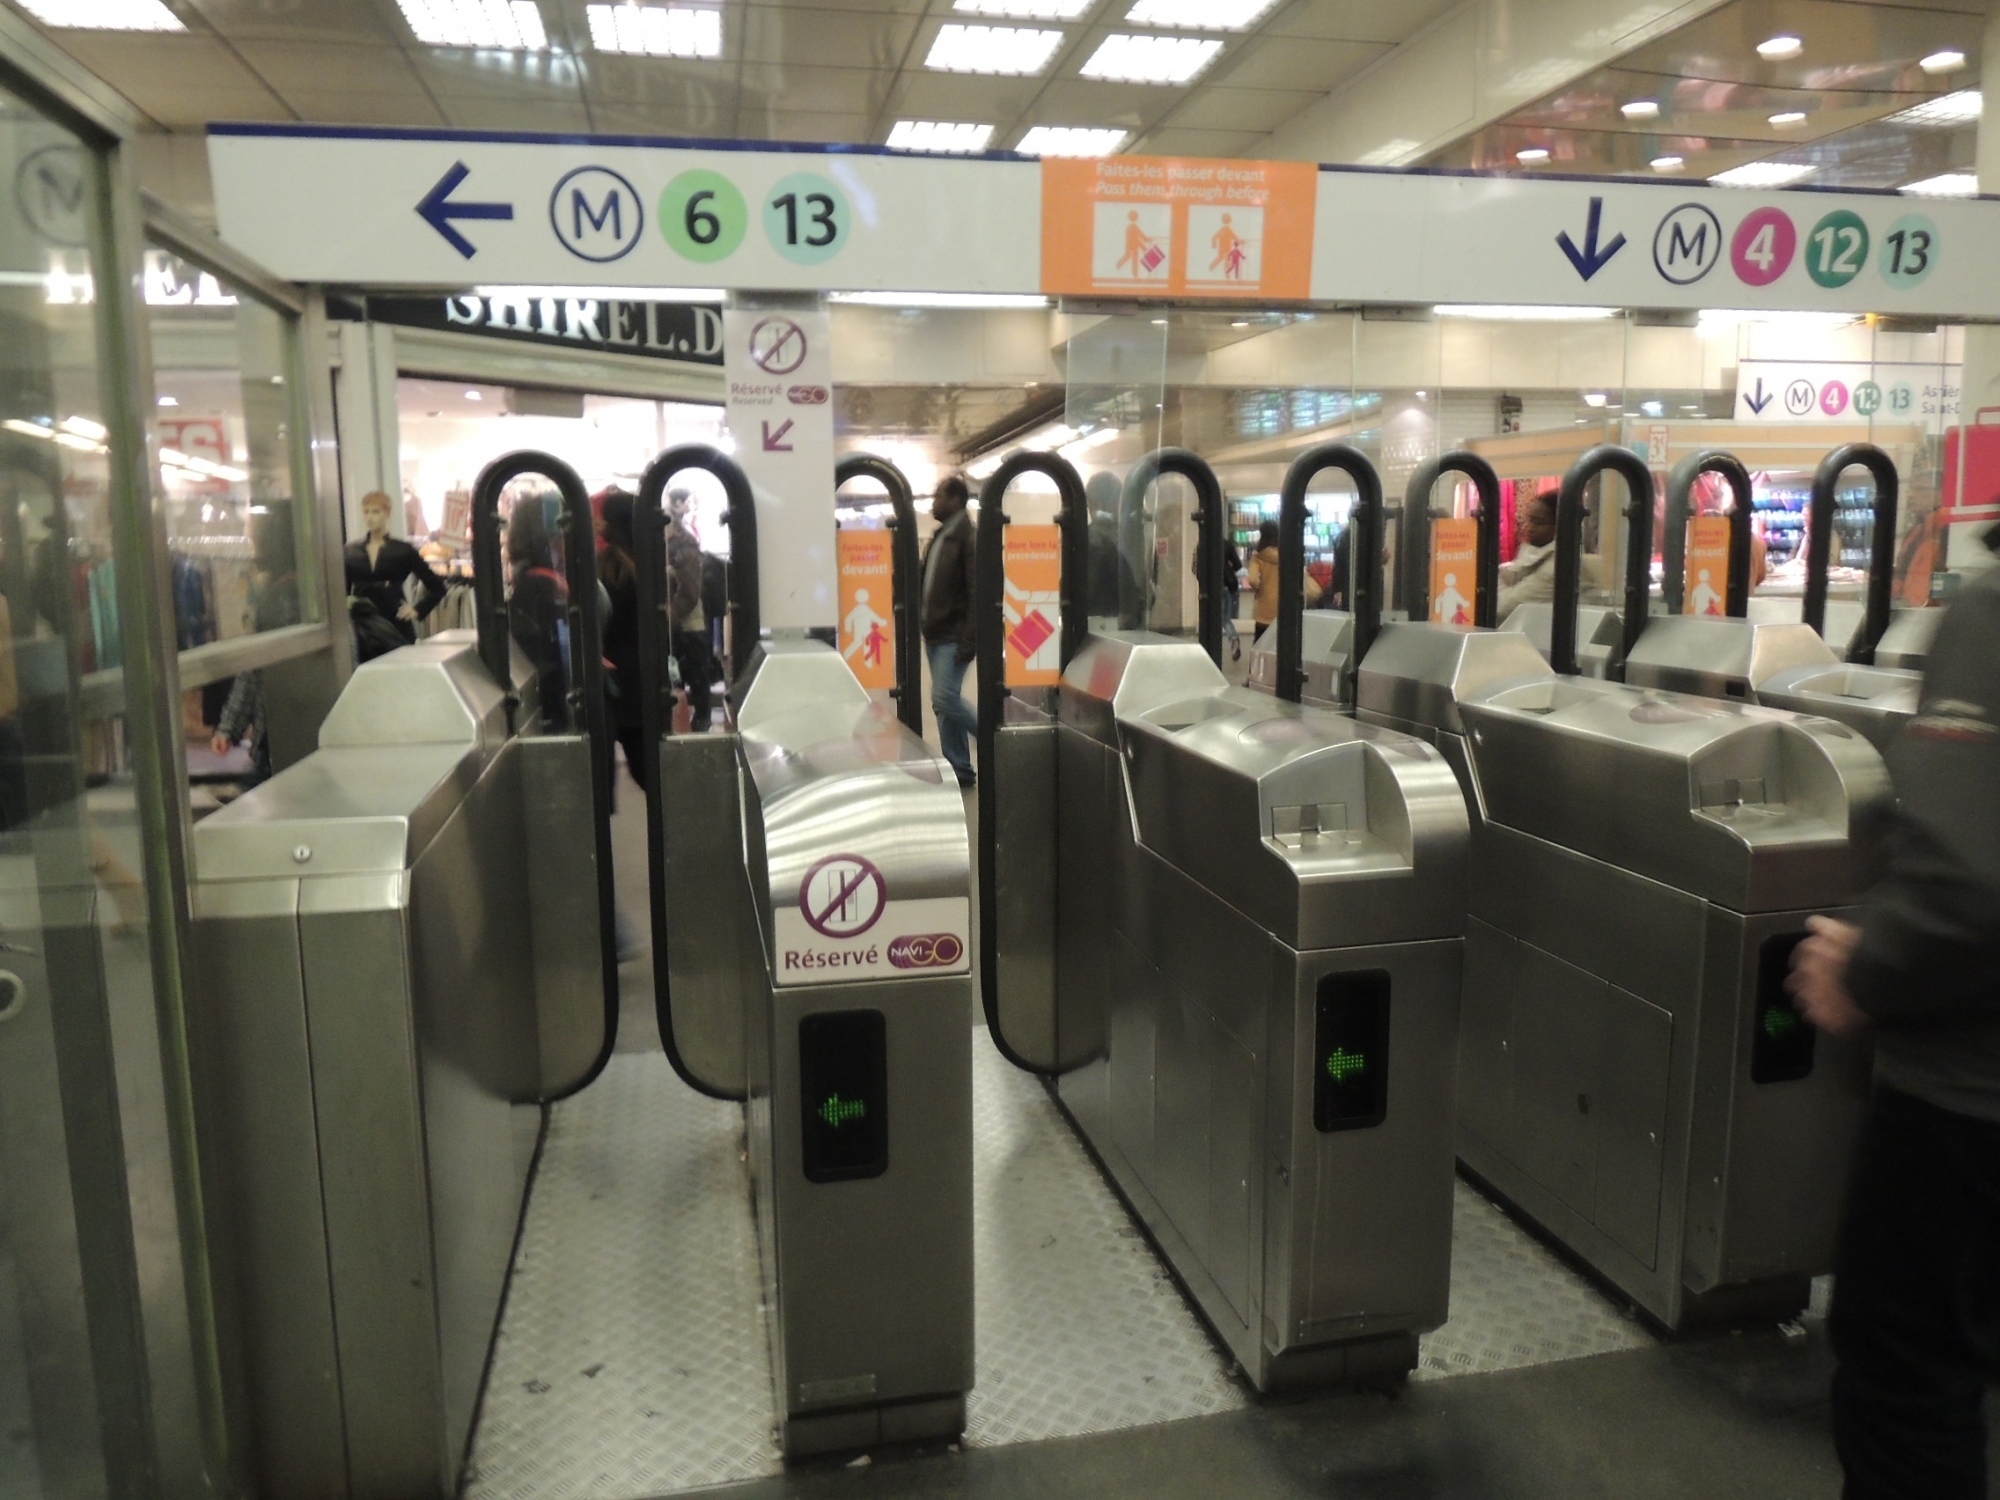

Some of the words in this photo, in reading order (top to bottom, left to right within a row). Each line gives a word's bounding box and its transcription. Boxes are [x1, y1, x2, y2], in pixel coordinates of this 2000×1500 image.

[1097, 162, 1163, 178] Faites-les
[1168, 166, 1213, 182] passer
[1218, 167, 1265, 182] devant
[1096, 181, 1126, 195] Pass
[1130, 182, 1165, 196] them
[1170, 183, 1223, 200] through
[1228, 185, 1269, 200] before
[572, 188, 622, 240] M
[684, 190, 720, 244] 6
[772, 193, 838, 246] 13
[1668, 221, 1707, 266] M
[1744, 223, 1775, 270] 4
[1813, 226, 1862, 273] 12
[1887, 229, 1931, 275] 13
[731, 382, 782, 395] Réservé
[1825, 387, 1840, 409] 4
[1856, 387, 1877, 409] 12
[1889, 388, 1909, 409] 13
[785, 943, 878, 970] Réservé
